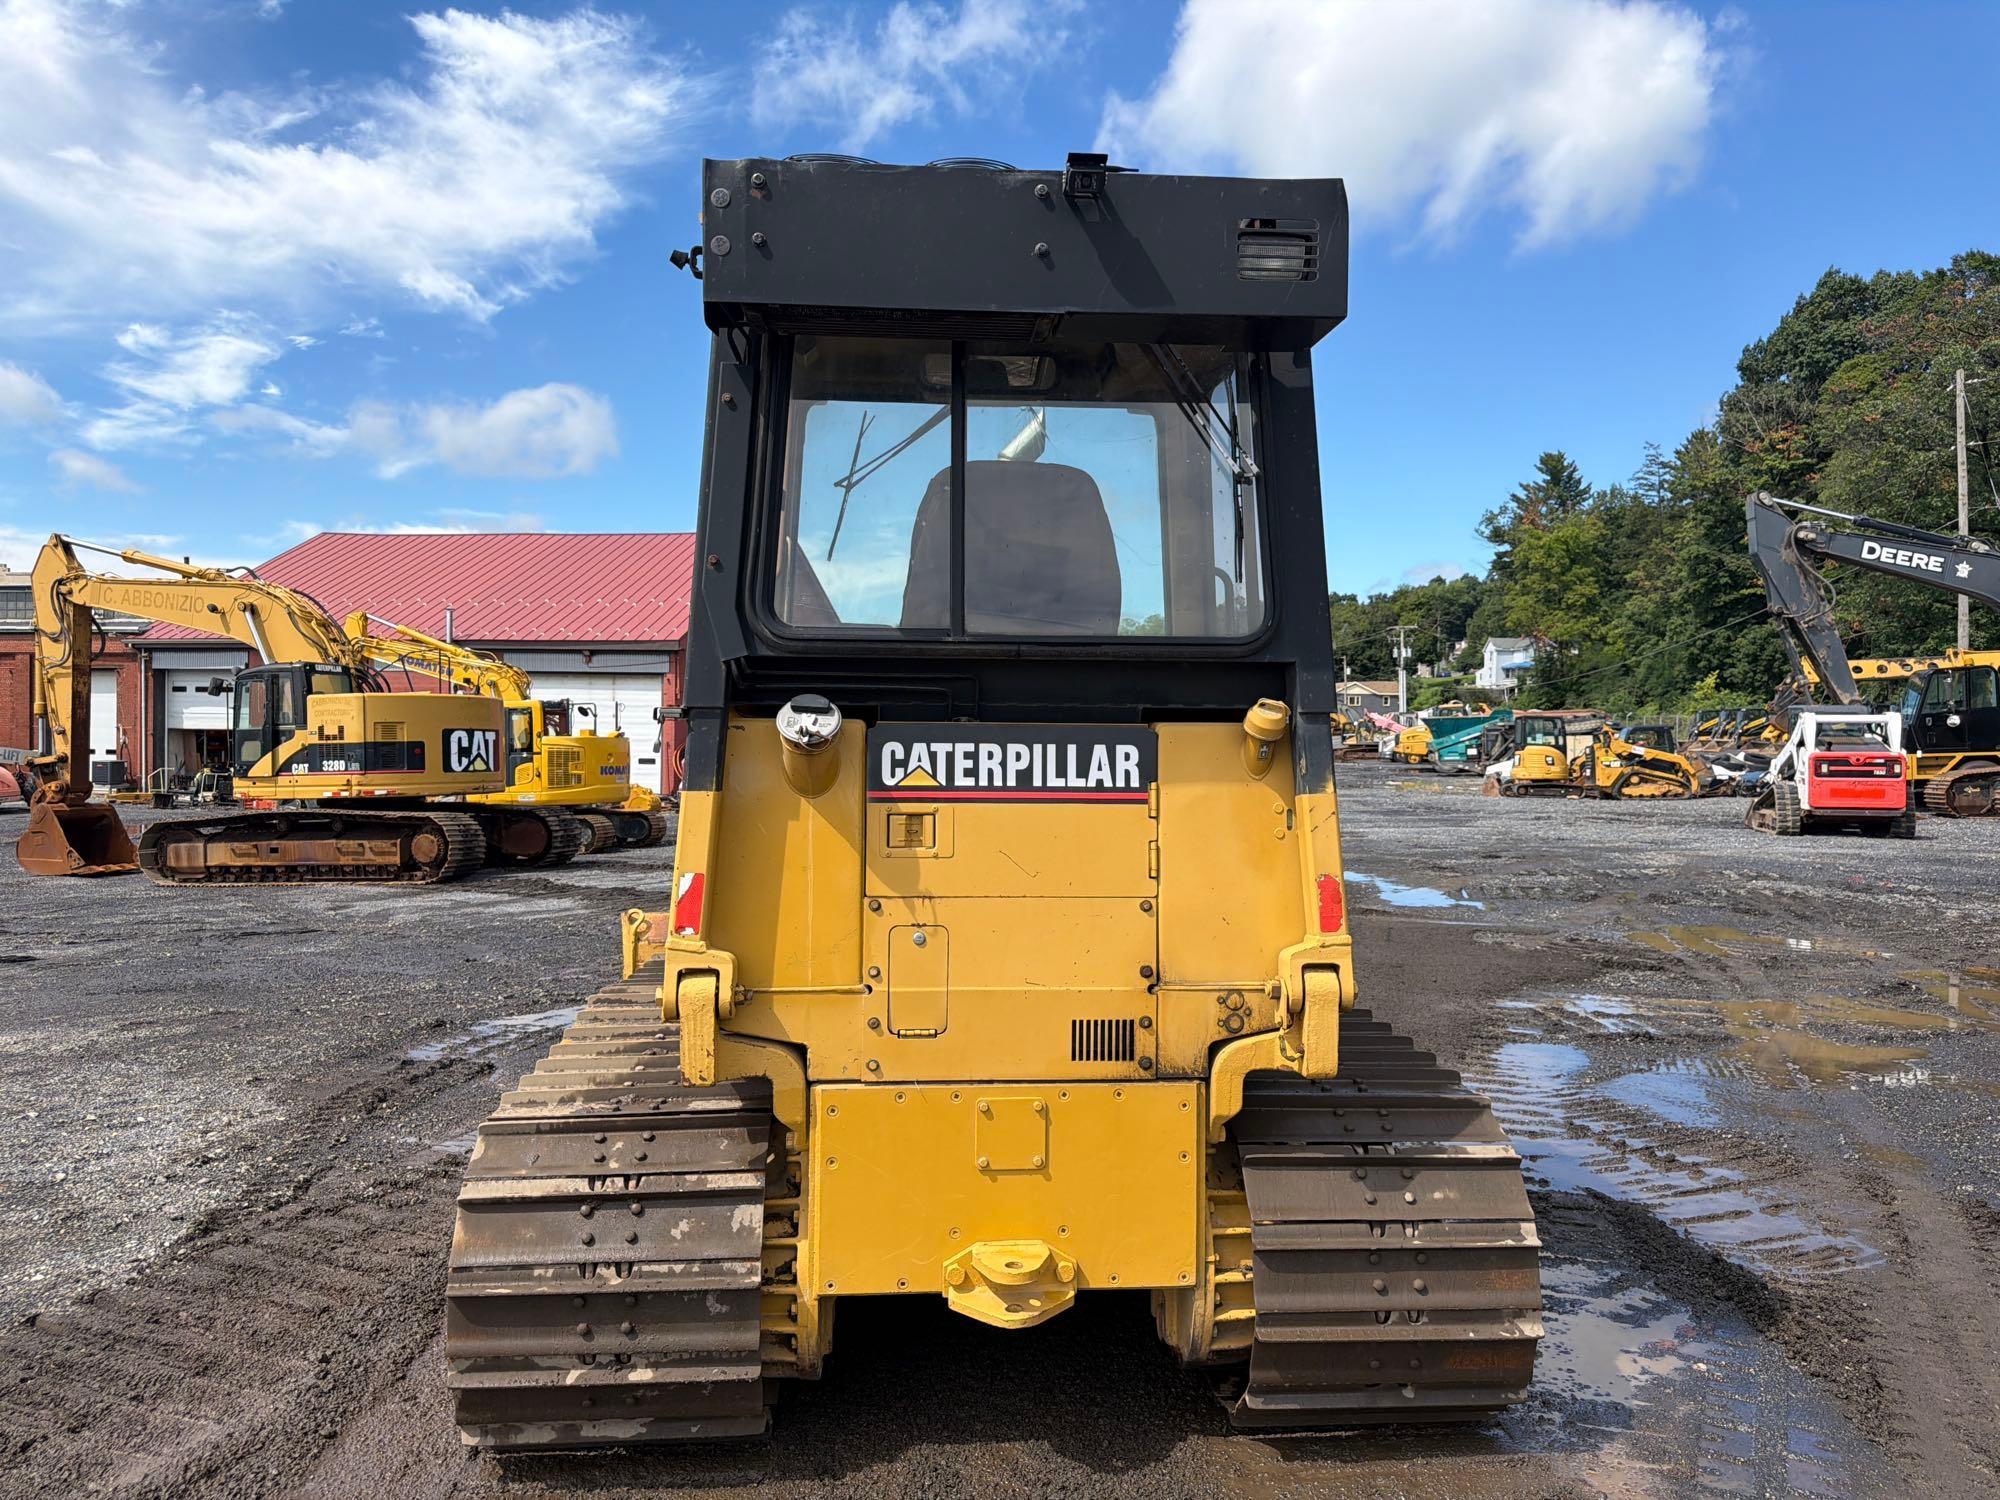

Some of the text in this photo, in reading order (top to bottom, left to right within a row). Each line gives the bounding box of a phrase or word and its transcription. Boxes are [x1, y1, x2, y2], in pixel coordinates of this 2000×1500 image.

[1861, 541, 1945, 573] DEERE
[103, 587, 205, 613] C. ABBONIZIO
[450, 730, 496, 772] CAT
[881, 741, 1140, 788] CATERPILLAR
[291, 763, 309, 775] CAT
[322, 760, 346, 772] 328D
